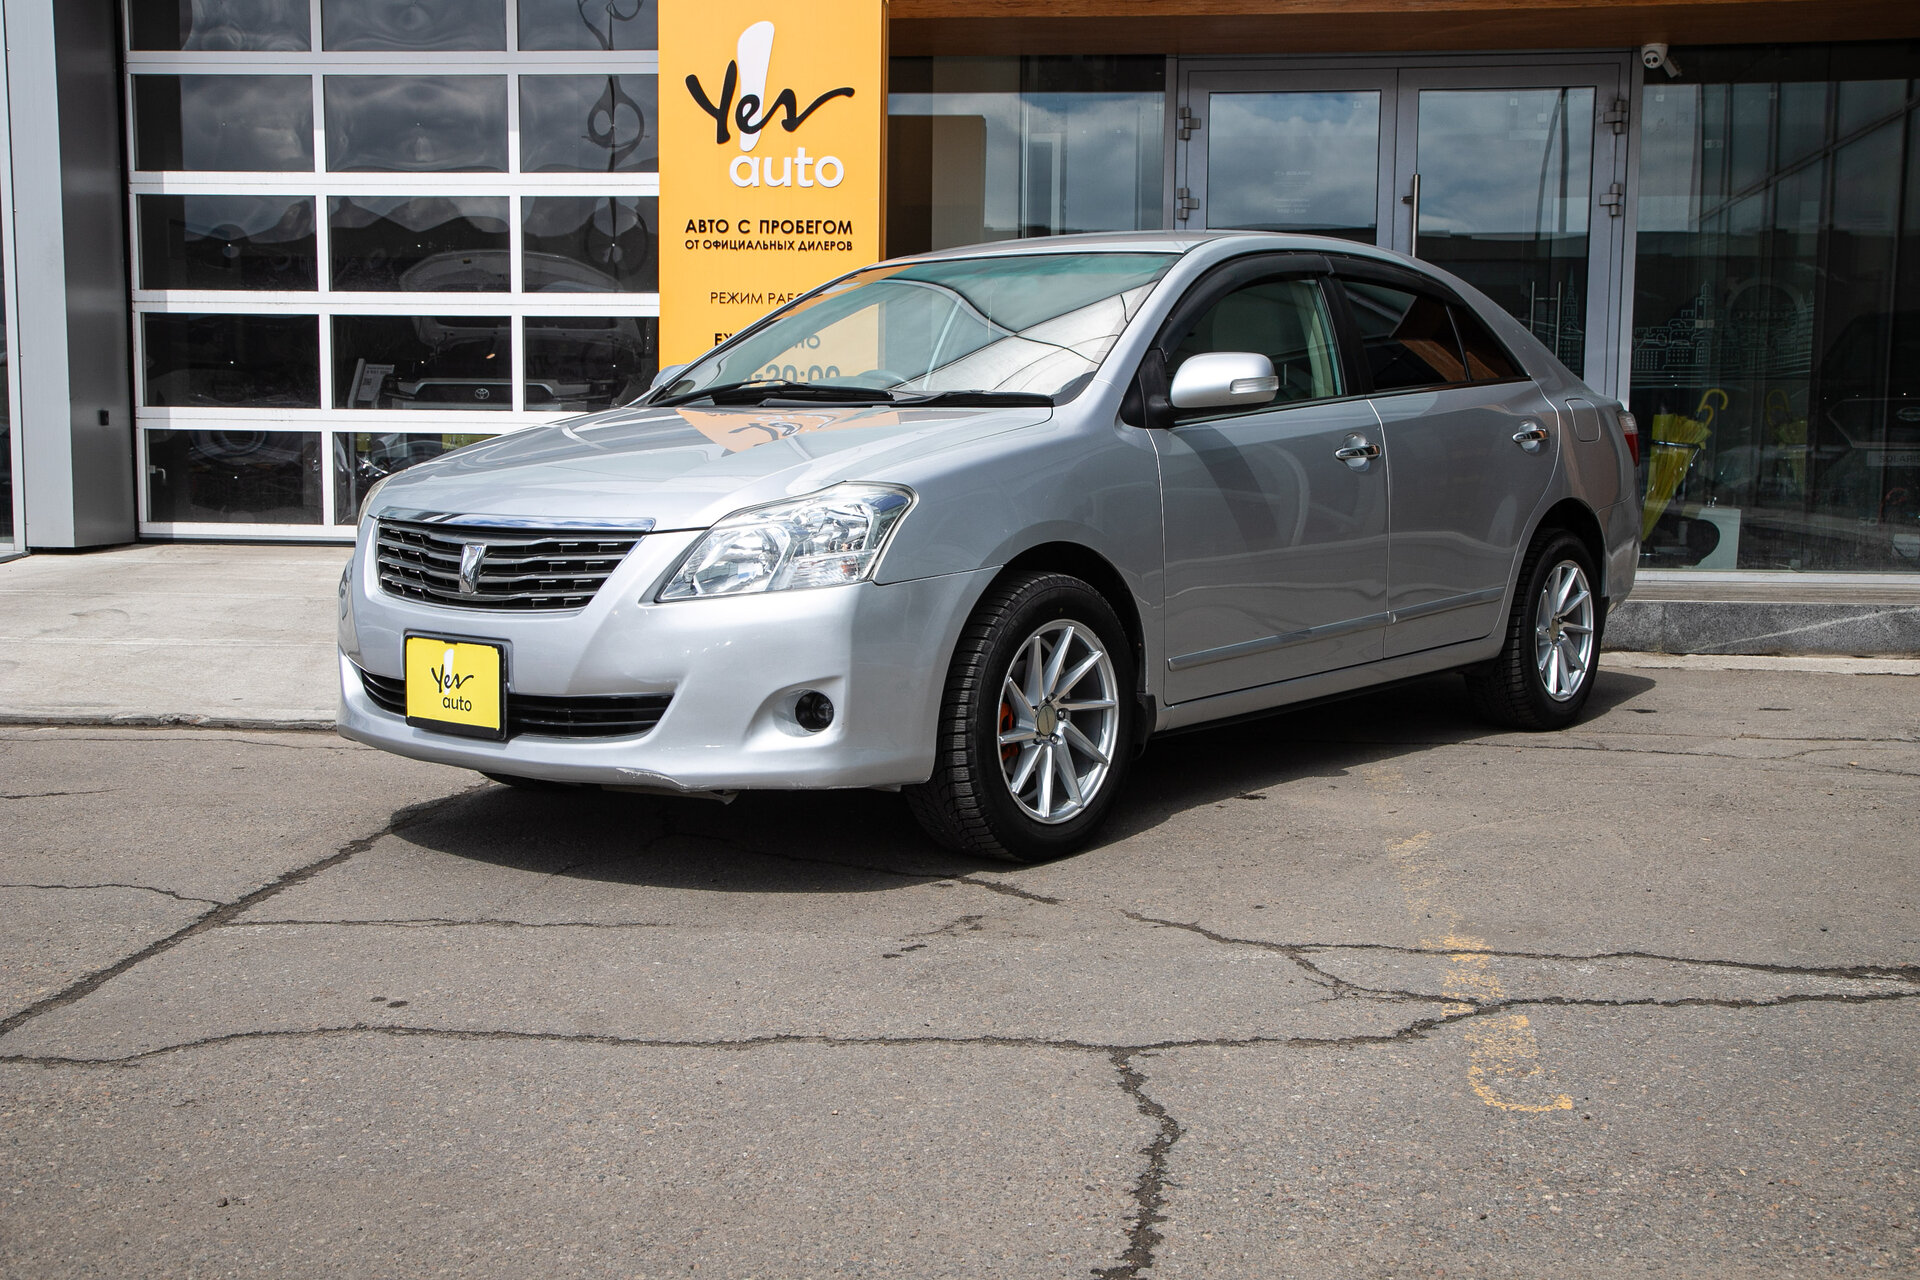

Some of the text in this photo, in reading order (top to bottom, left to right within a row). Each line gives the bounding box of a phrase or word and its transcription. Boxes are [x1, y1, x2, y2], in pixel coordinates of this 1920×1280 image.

[685, 59, 856, 145] Yes
[729, 147, 845, 188] auto
[685, 219, 853, 235] АВТО С ПРОБЕГОМ
[685, 239, 853, 252] ОТ ОФИЦИАЛЬНЫХ ДИЛЕРОВ
[710, 291, 764, 305] РЕЖИМ
[430, 663, 475, 694] Yes
[442, 696, 472, 712] auto
